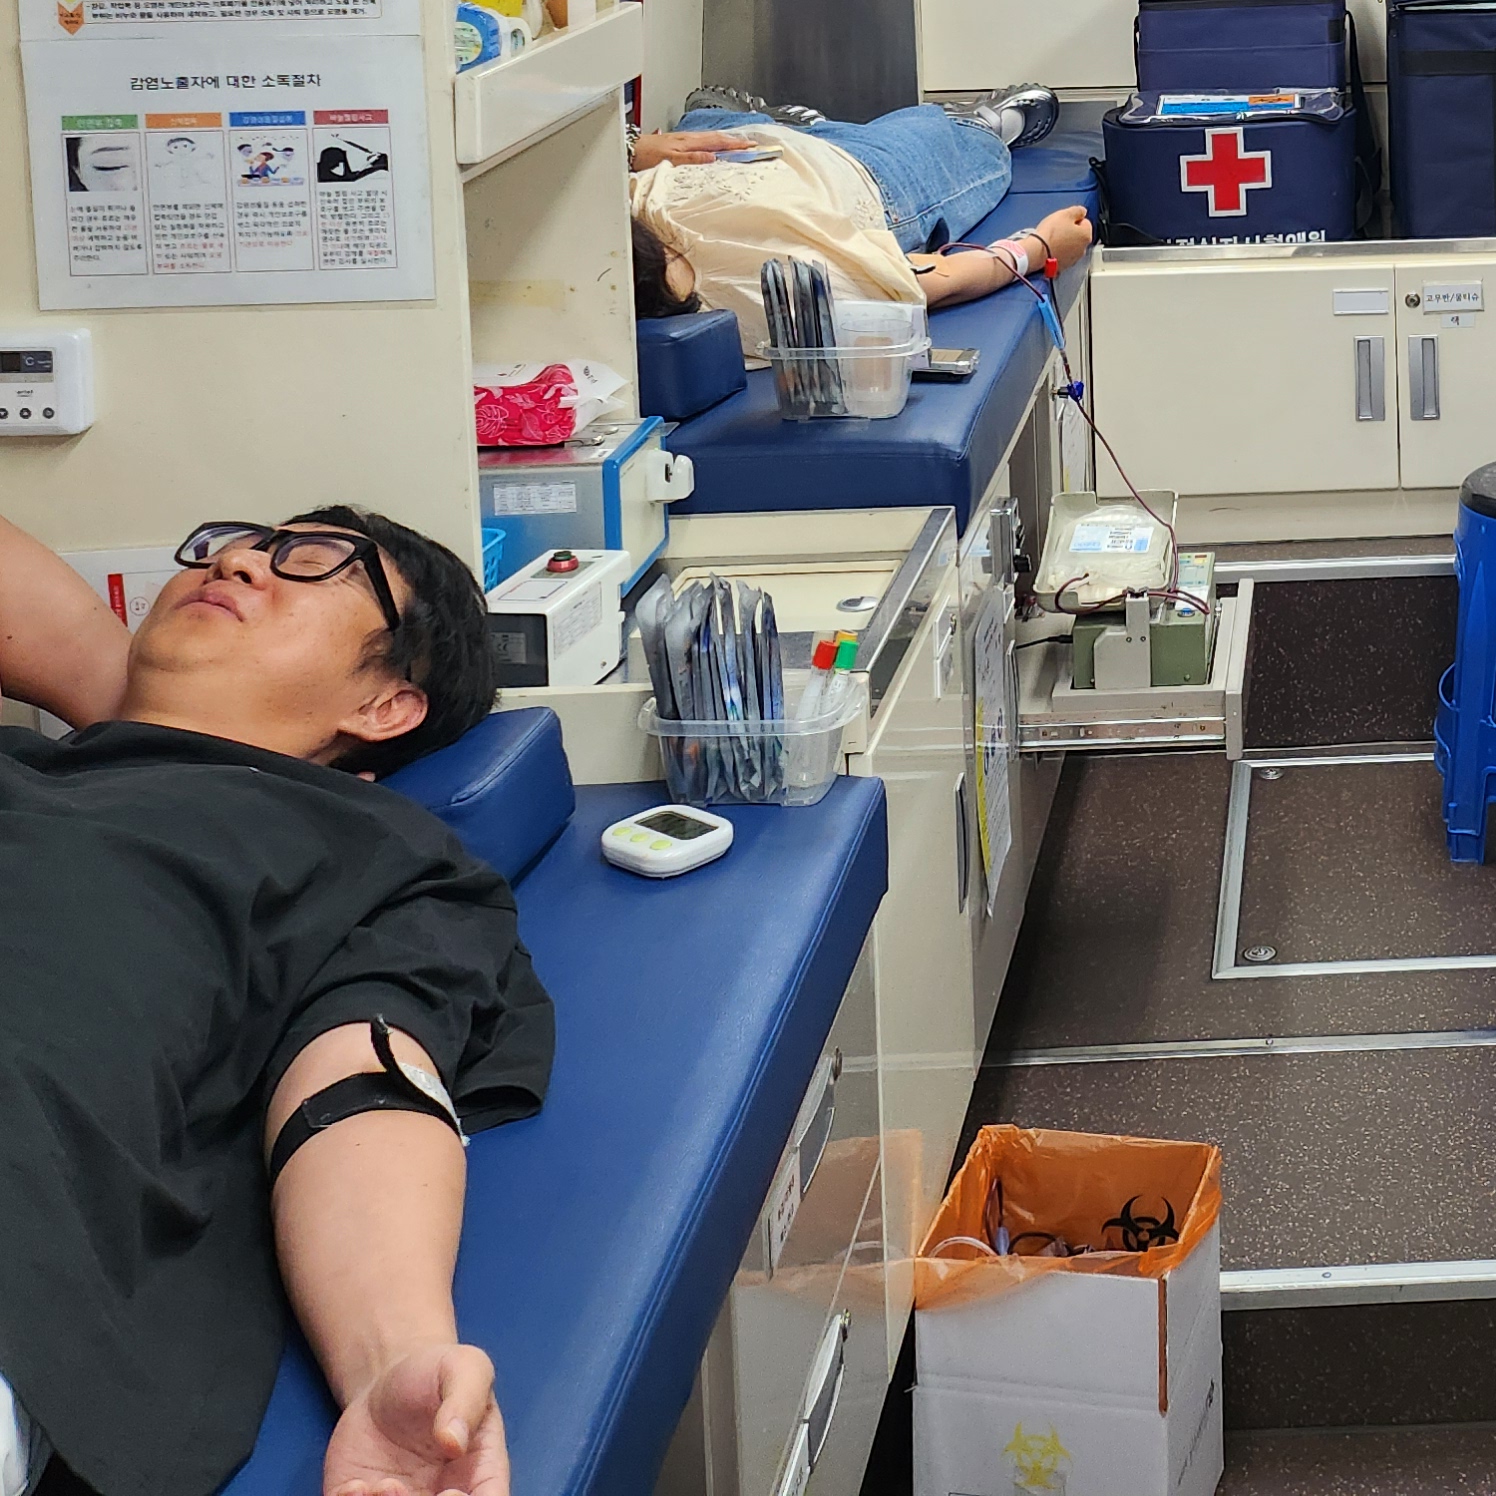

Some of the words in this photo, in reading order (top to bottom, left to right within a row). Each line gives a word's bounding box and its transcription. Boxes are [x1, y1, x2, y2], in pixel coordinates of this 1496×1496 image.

[130, 75, 220, 92] 감염노출자에
[226, 75, 256, 90] 대한
[262, 74, 322, 89] 소독절차
